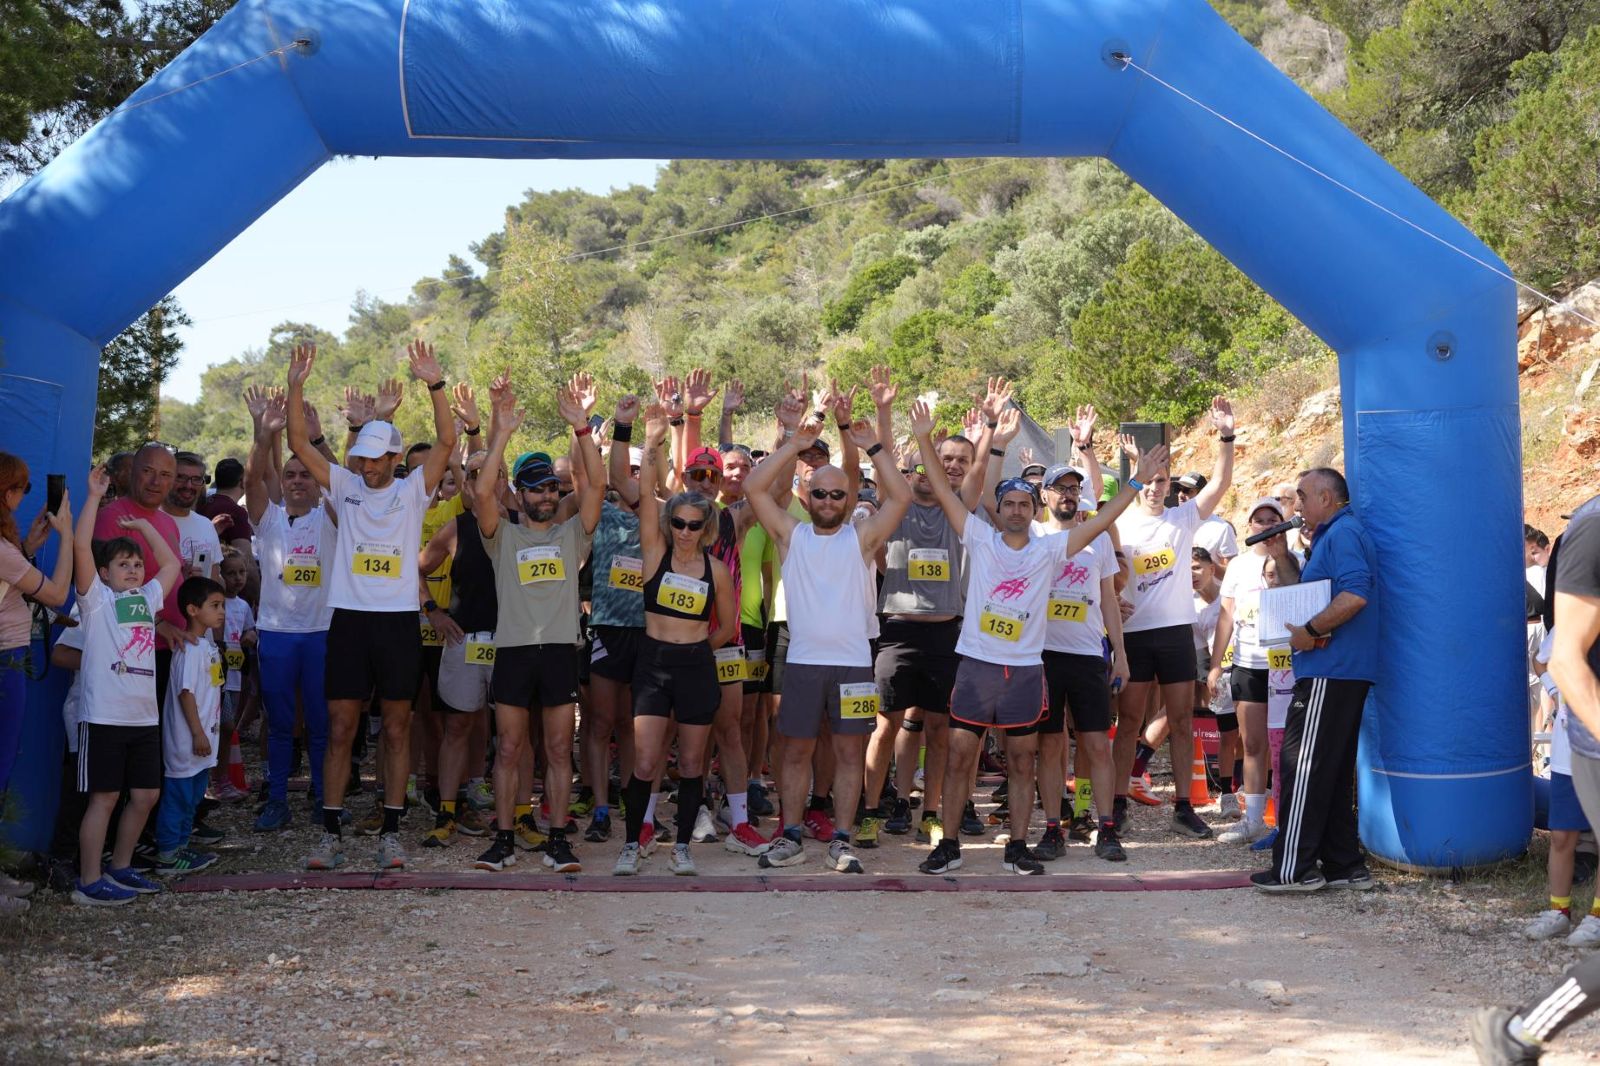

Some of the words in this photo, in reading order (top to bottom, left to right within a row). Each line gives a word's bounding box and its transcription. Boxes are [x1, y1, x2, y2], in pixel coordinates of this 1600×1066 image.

[364, 558, 391, 573] 134
[1144, 553, 1169, 570] 296
[294, 569, 317, 582] 267
[530, 562, 557, 578] 276
[919, 564, 942, 577] 138
[619, 573, 643, 588] 282
[669, 591, 695, 609] 183
[1054, 604, 1080, 618] 277
[988, 618, 1014, 636] 153
[476, 647, 496, 661] 26
[719, 663, 740, 678] 197
[853, 699, 875, 714] 286
